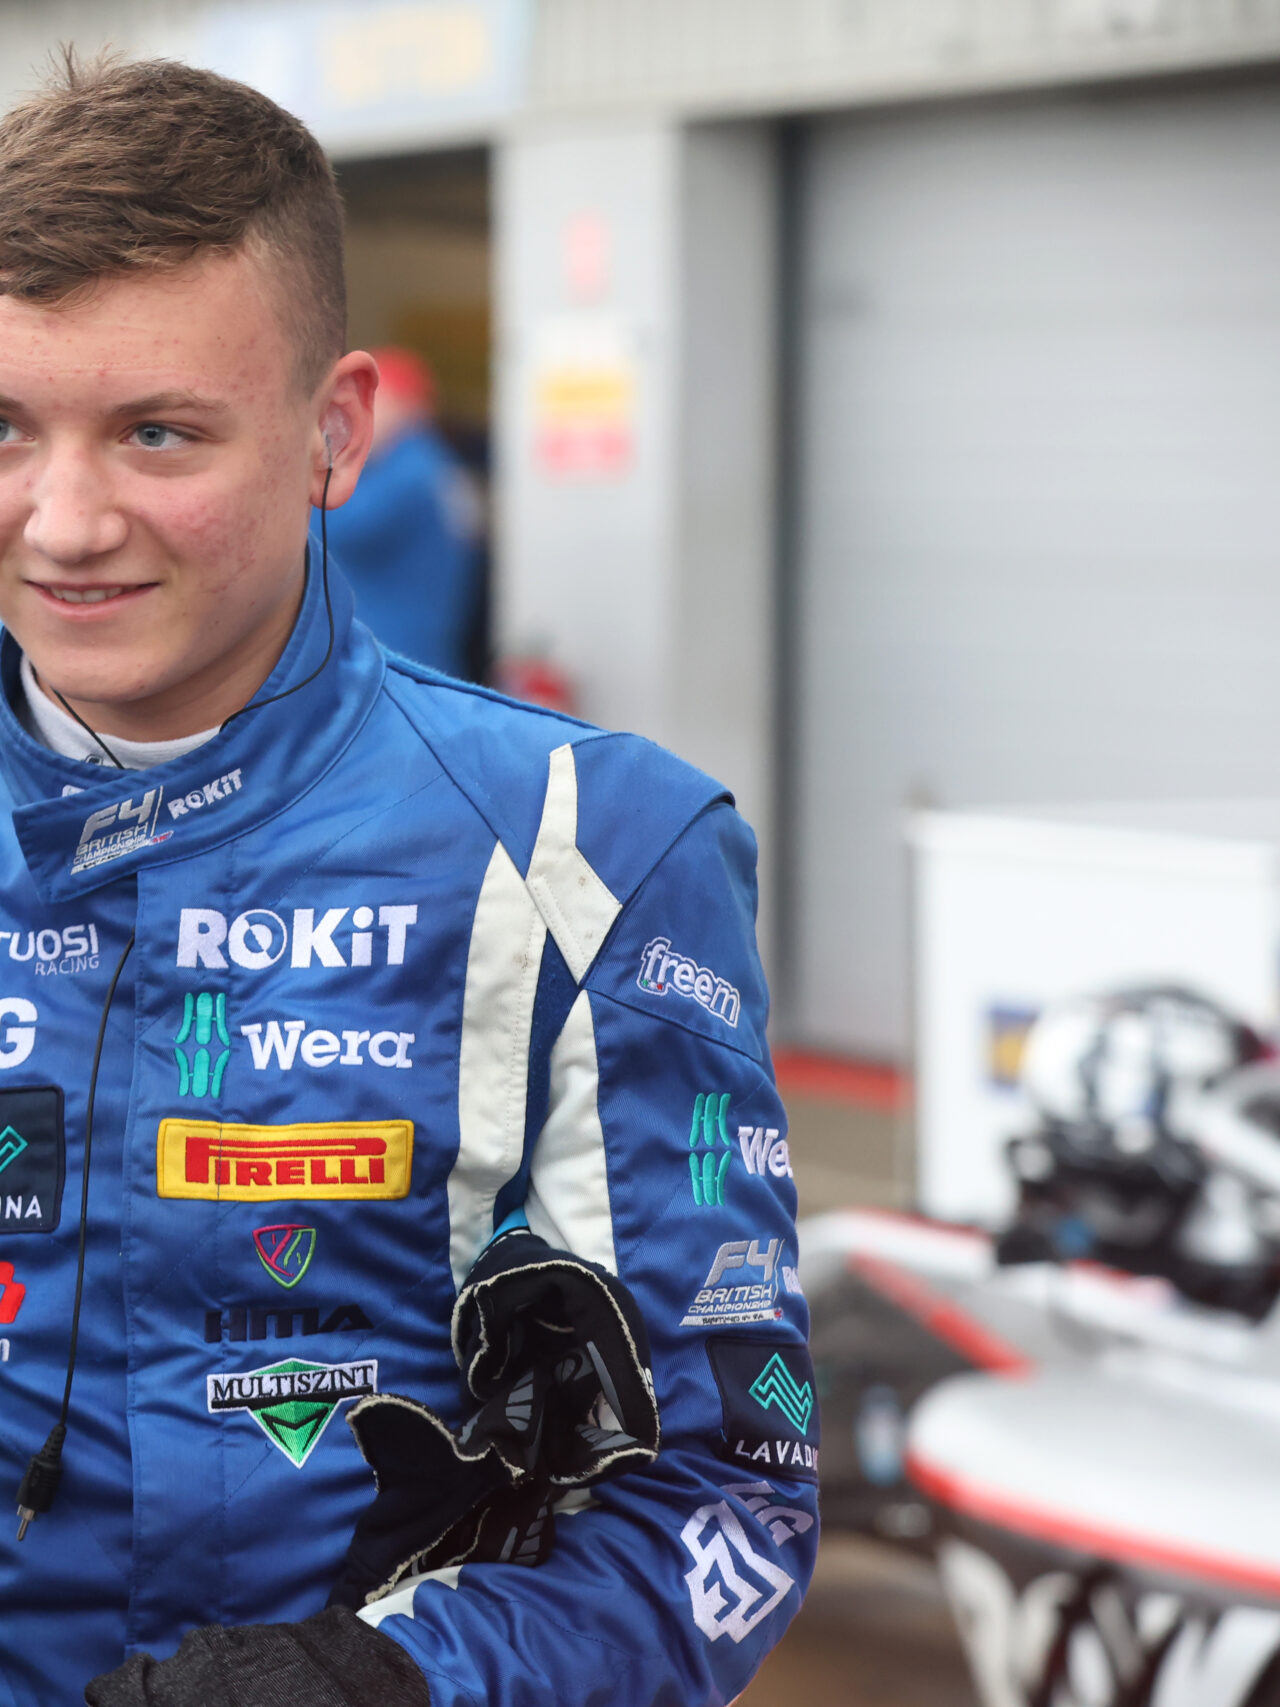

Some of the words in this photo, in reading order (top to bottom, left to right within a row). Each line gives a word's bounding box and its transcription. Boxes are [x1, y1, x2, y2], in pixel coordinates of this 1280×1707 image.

[167, 768, 242, 820] ROKiT
[80, 789, 156, 844] F4
[73, 834, 147, 866] CHAMPIONSHIP
[76, 821, 150, 857] BRITISH
[176, 904, 418, 970] ROKiT
[35, 954, 100, 976] RACING
[640, 939, 740, 1026] freem
[240, 1021, 415, 1071] Wera
[184, 1136, 387, 1186] PIRELLI
[703, 1239, 779, 1288] F4
[687, 1299, 772, 1314] CHAMPIONSHIP
[694, 1284, 773, 1304] BRITISH
[203, 1304, 375, 1343] HMA
[213, 1365, 374, 1402] MULTISZINT
